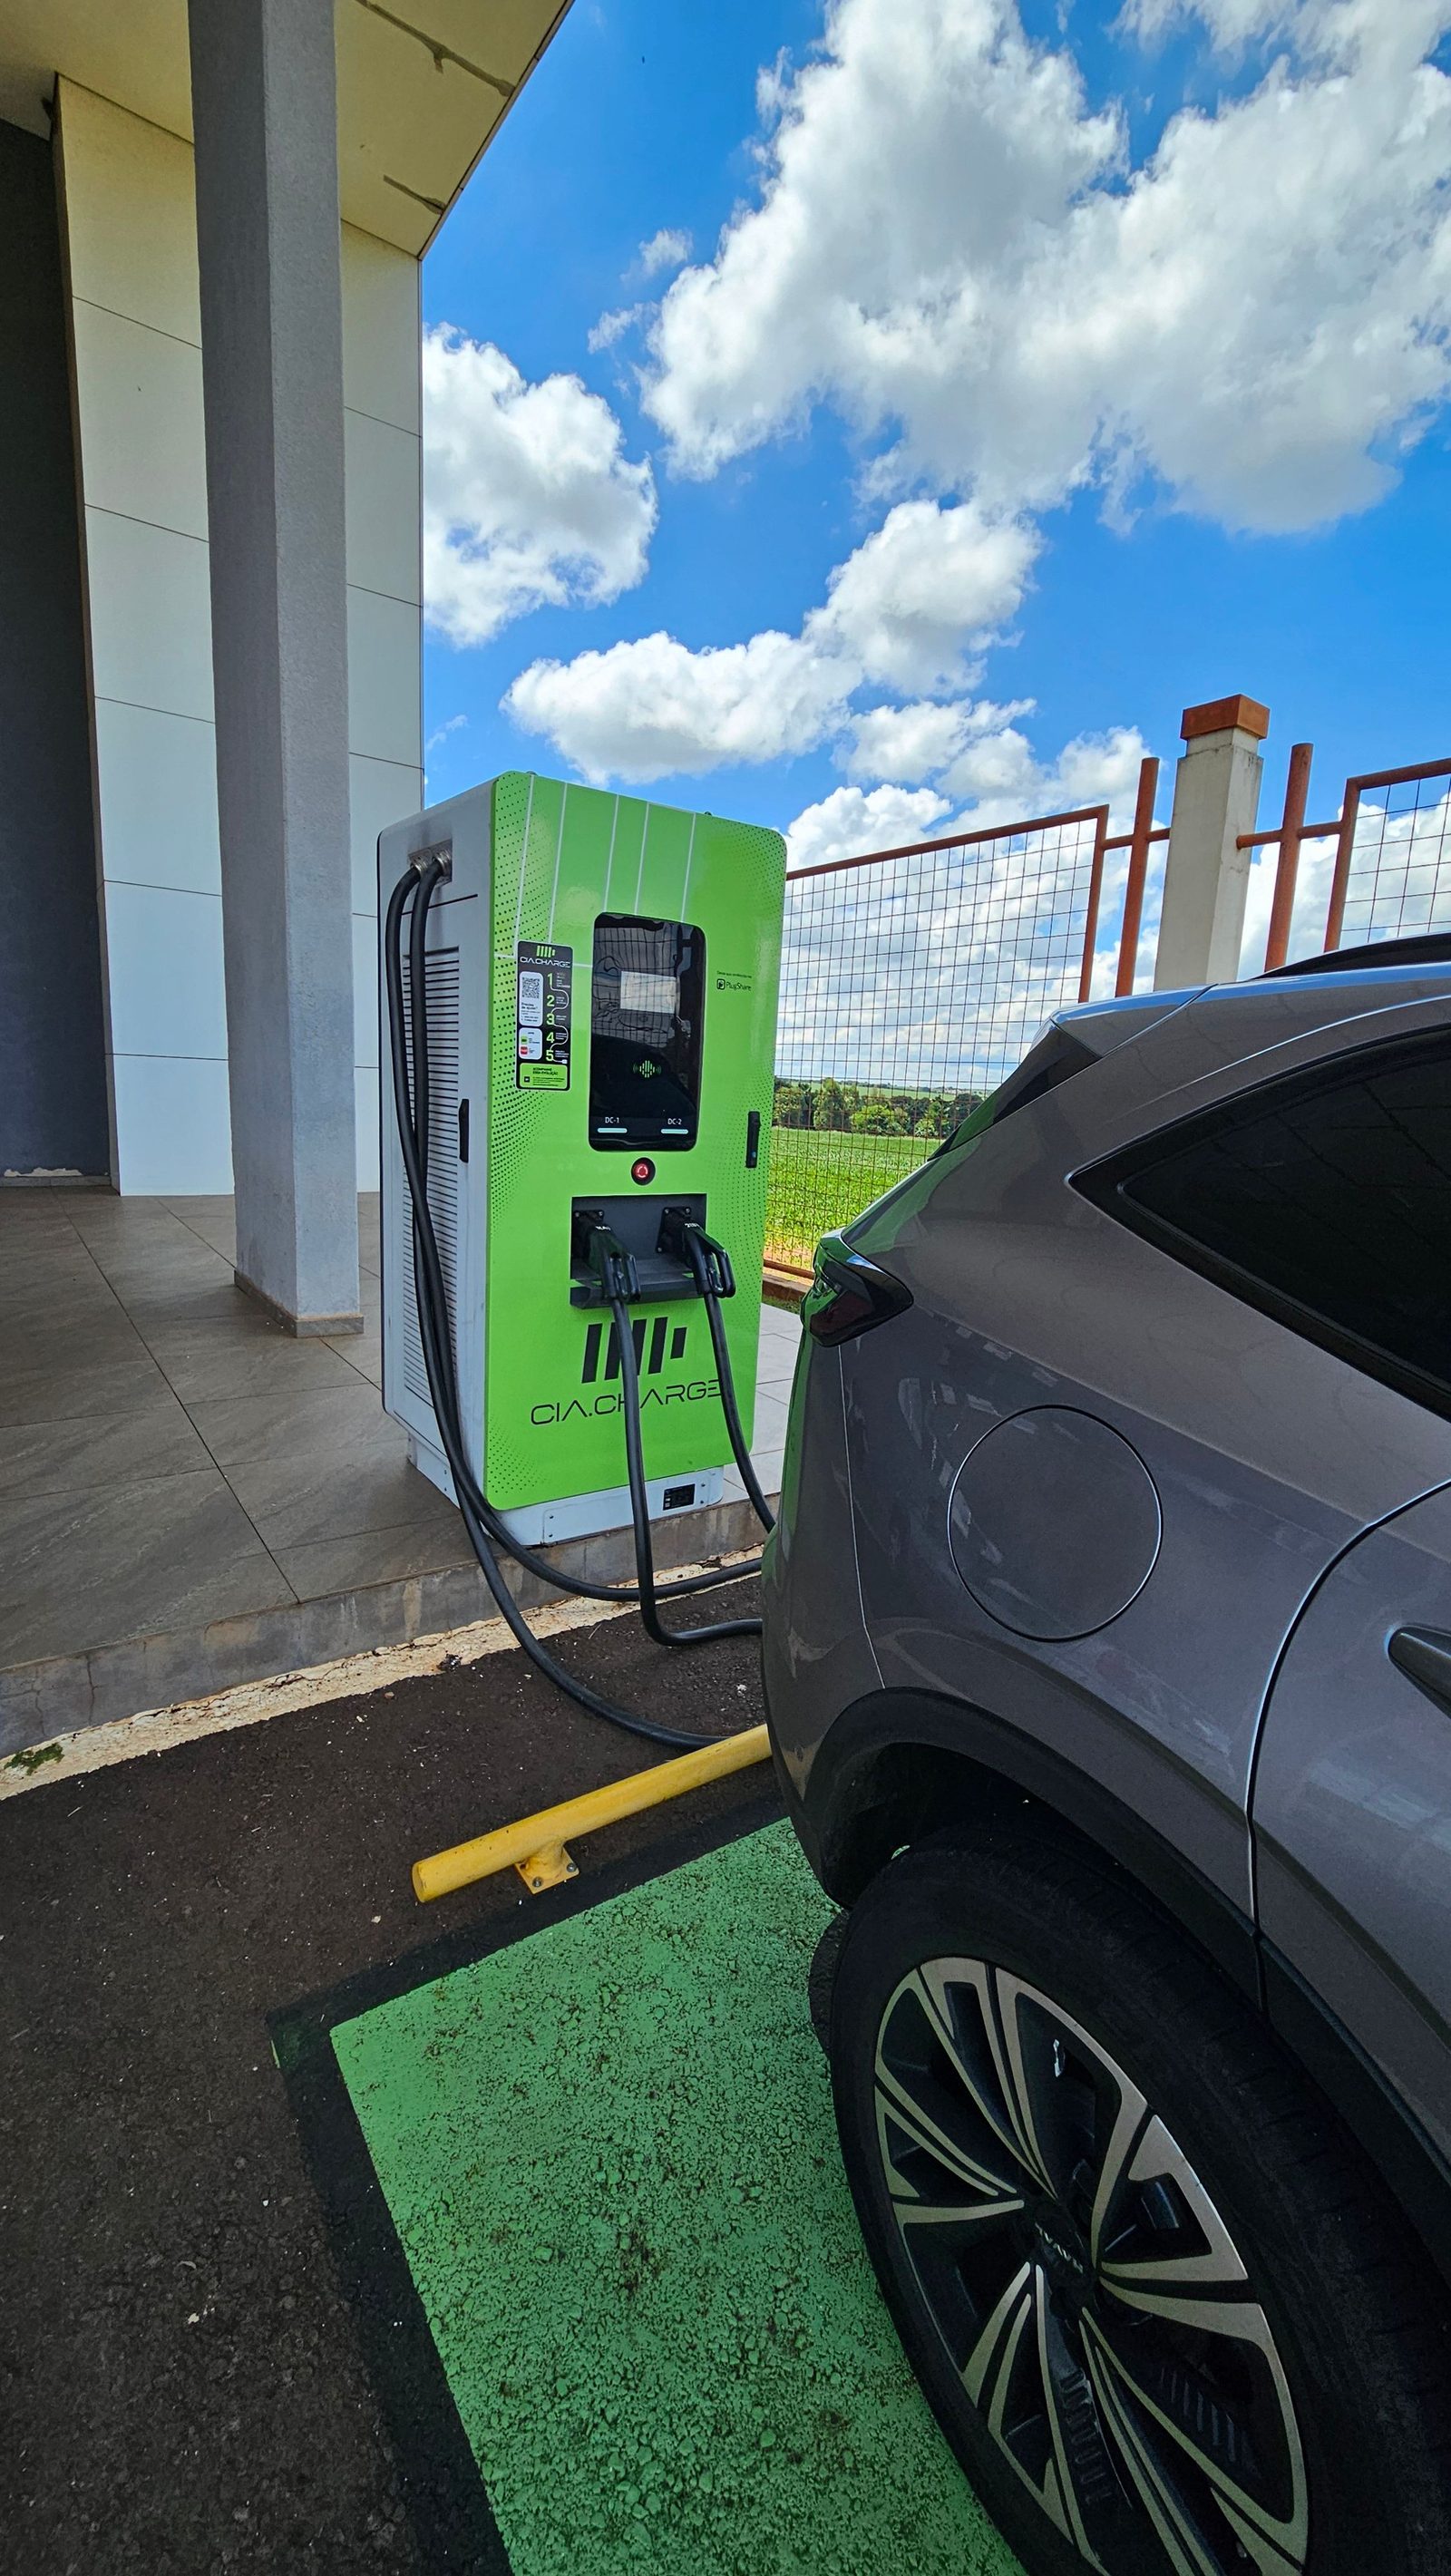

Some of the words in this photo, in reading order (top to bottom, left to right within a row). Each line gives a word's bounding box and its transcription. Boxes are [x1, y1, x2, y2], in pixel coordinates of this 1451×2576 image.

[547, 972, 553, 987] 1
[546, 995, 555, 1007] 2
[546, 1013, 555, 1026] 3
[546, 1032, 555, 1044] 4
[545, 1050, 554, 1062] 5
